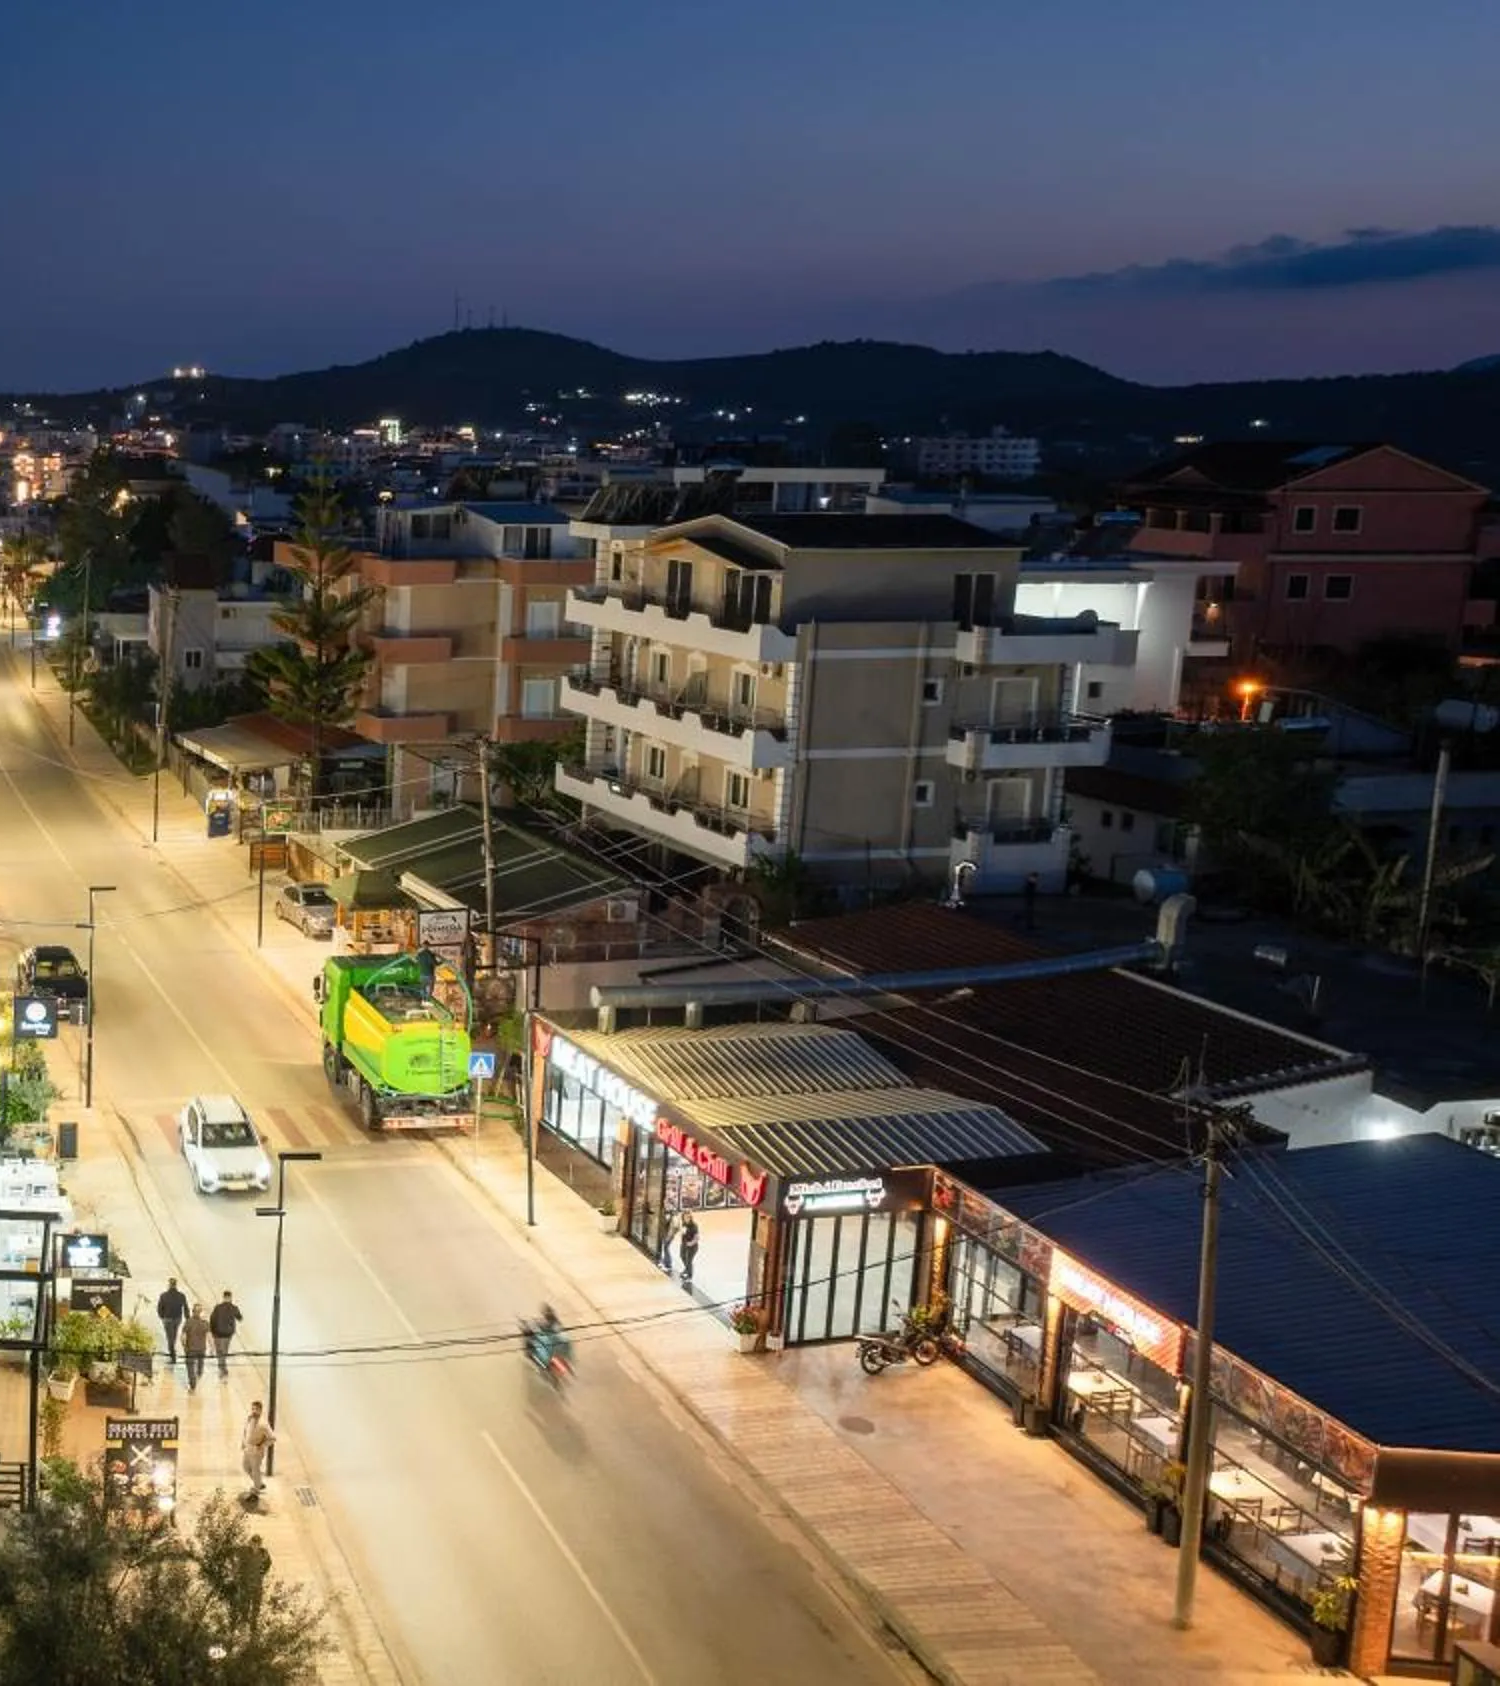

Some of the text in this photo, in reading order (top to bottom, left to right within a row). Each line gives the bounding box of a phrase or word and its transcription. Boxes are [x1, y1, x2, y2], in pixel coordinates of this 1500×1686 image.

[596, 1068, 658, 1132] HOUSE
[657, 1117, 687, 1153] Grill
[697, 1146, 731, 1185] Chill
